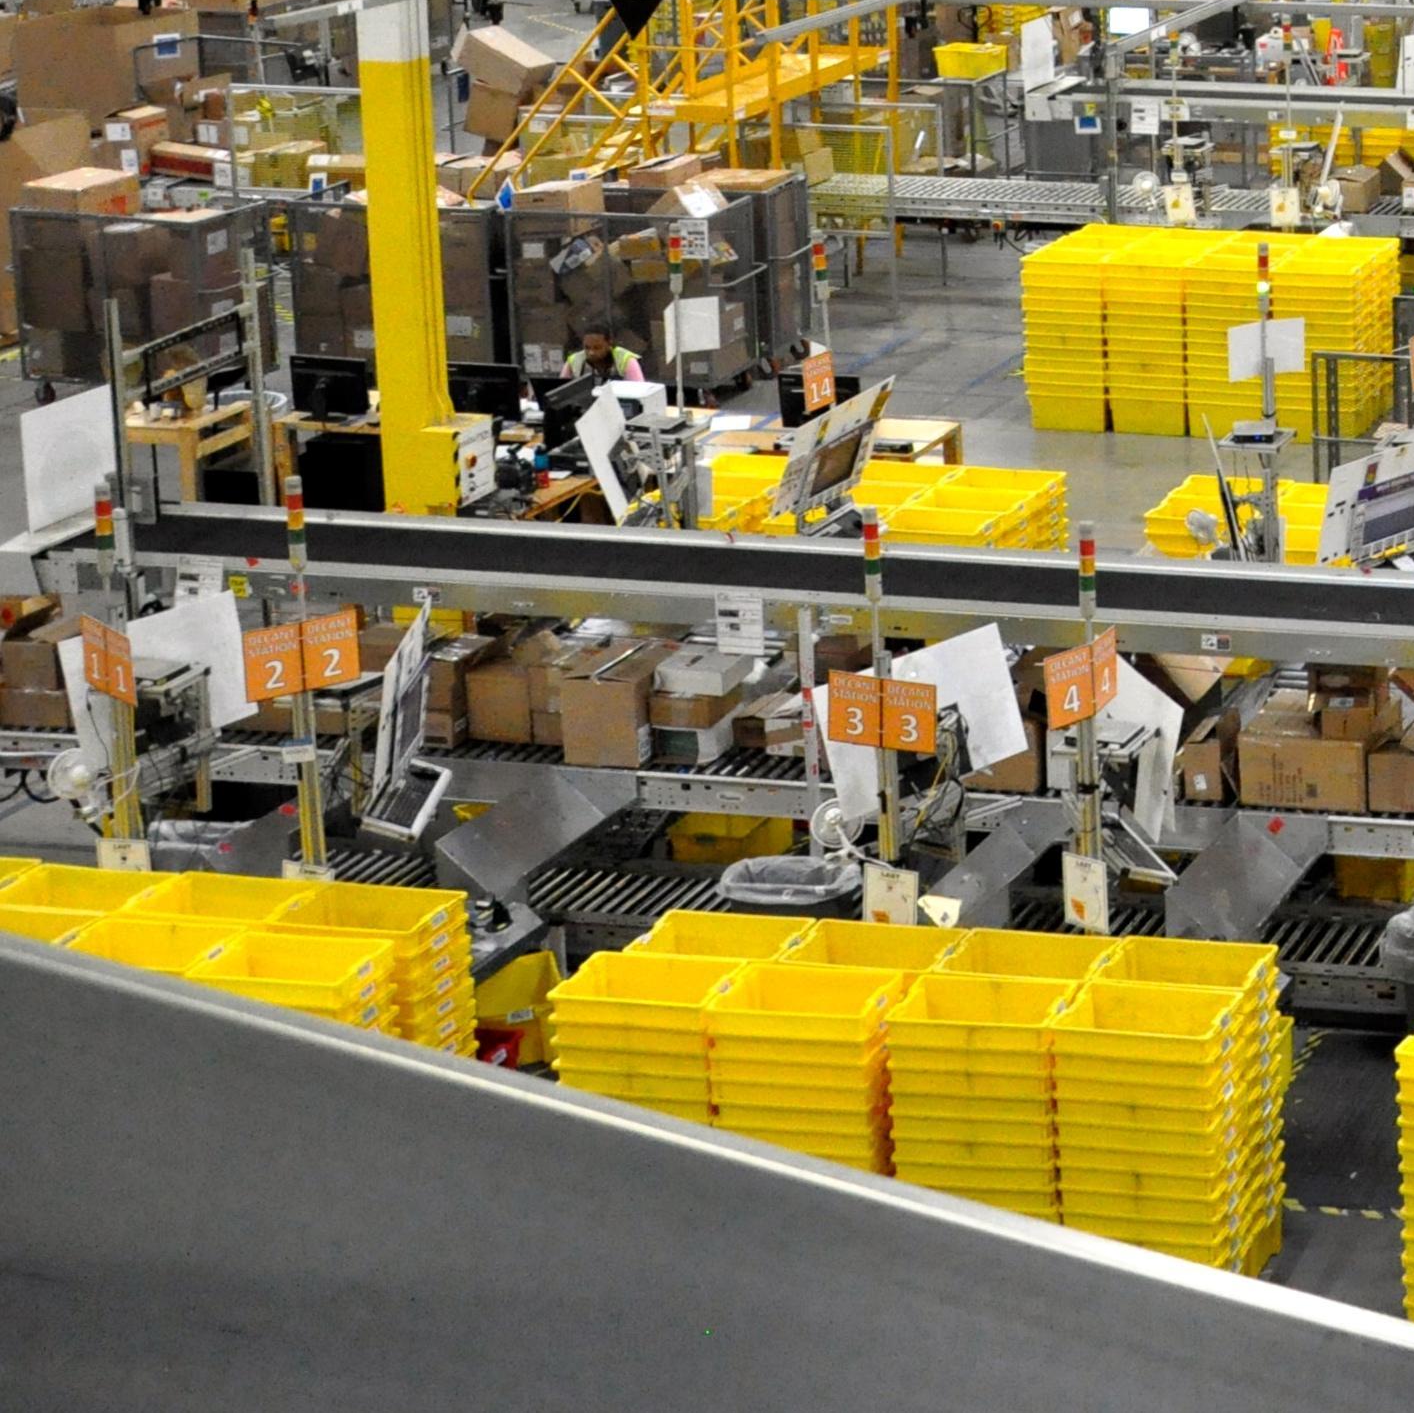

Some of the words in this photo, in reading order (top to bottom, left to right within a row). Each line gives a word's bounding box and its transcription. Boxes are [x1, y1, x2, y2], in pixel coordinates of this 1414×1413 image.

[811, 377, 832, 404] 14
[304, 629, 354, 645] STATION
[91, 652, 101, 680] 1
[264, 660, 286, 690] 2
[322, 647, 343, 678] 2
[116, 665, 127, 693] 1
[1100, 666, 1112, 694] 4
[1063, 684, 1081, 713] 4
[845, 706, 865, 736] 3
[899, 714, 919, 744] 3
